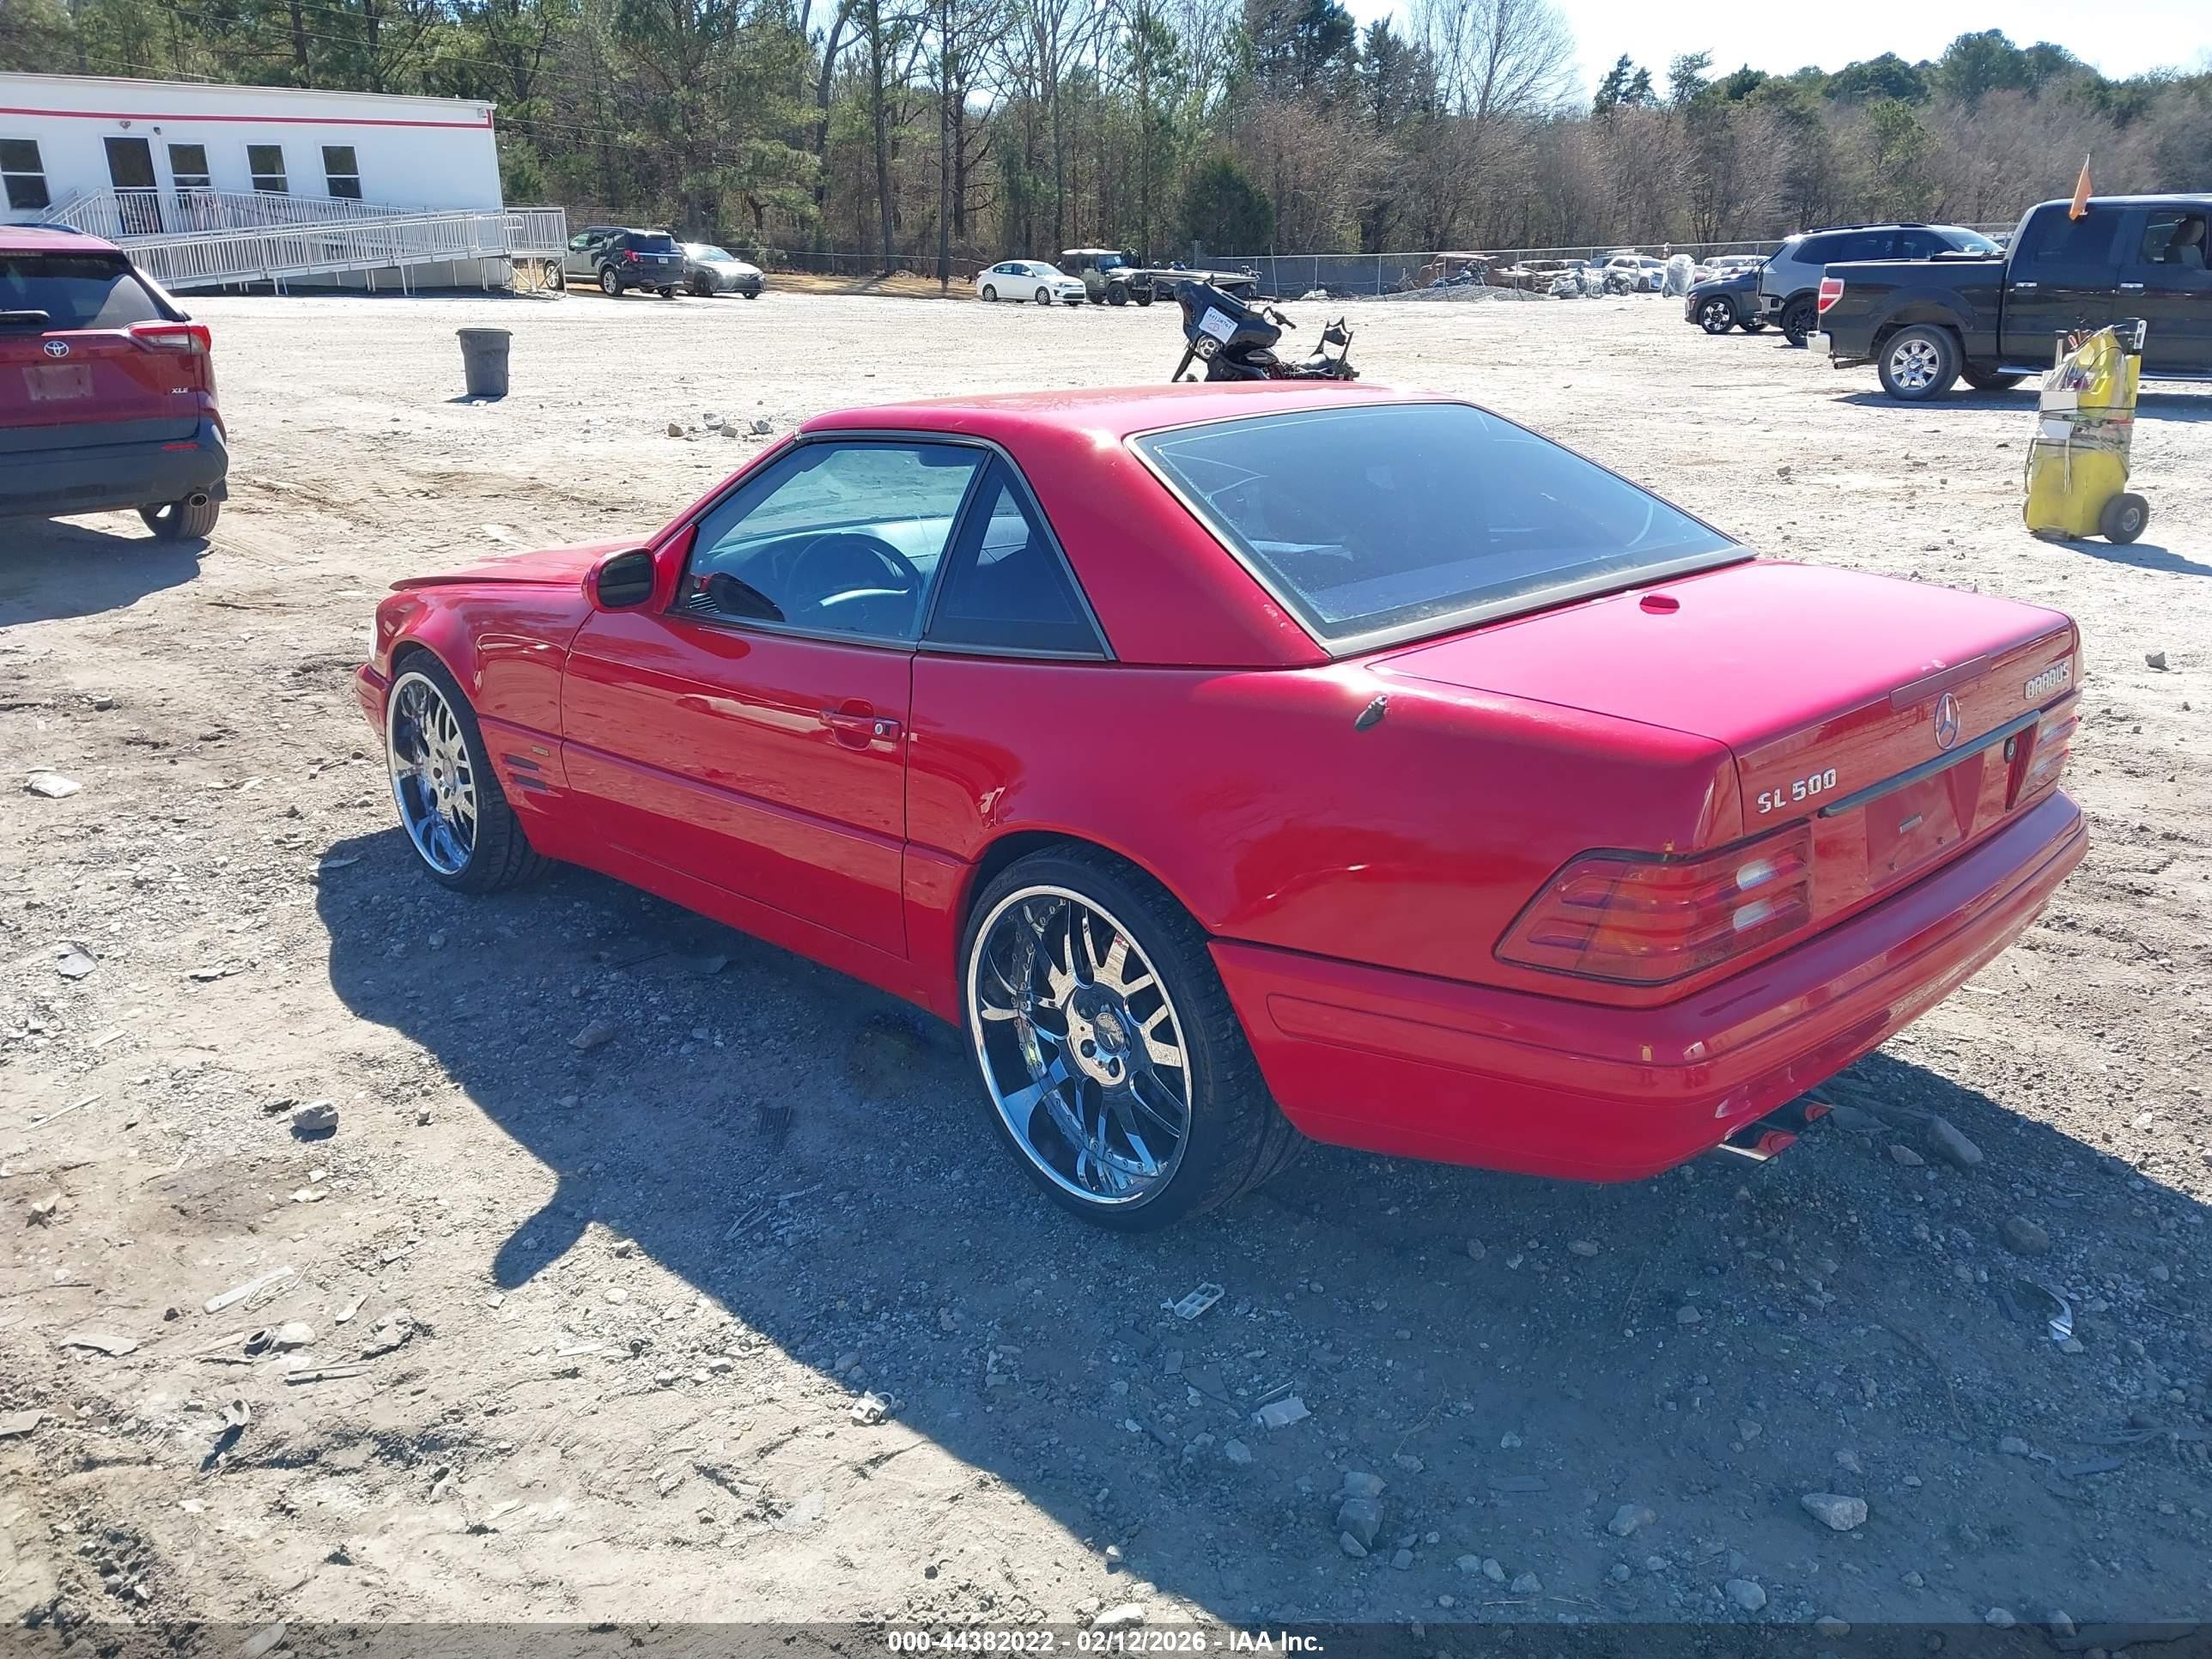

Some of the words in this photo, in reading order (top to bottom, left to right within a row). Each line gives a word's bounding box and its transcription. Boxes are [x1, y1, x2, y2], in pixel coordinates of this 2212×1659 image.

[2025, 661, 2069, 699] BRABUS
[1757, 788, 1787, 814] SL
[1792, 769, 1836, 801] 500
